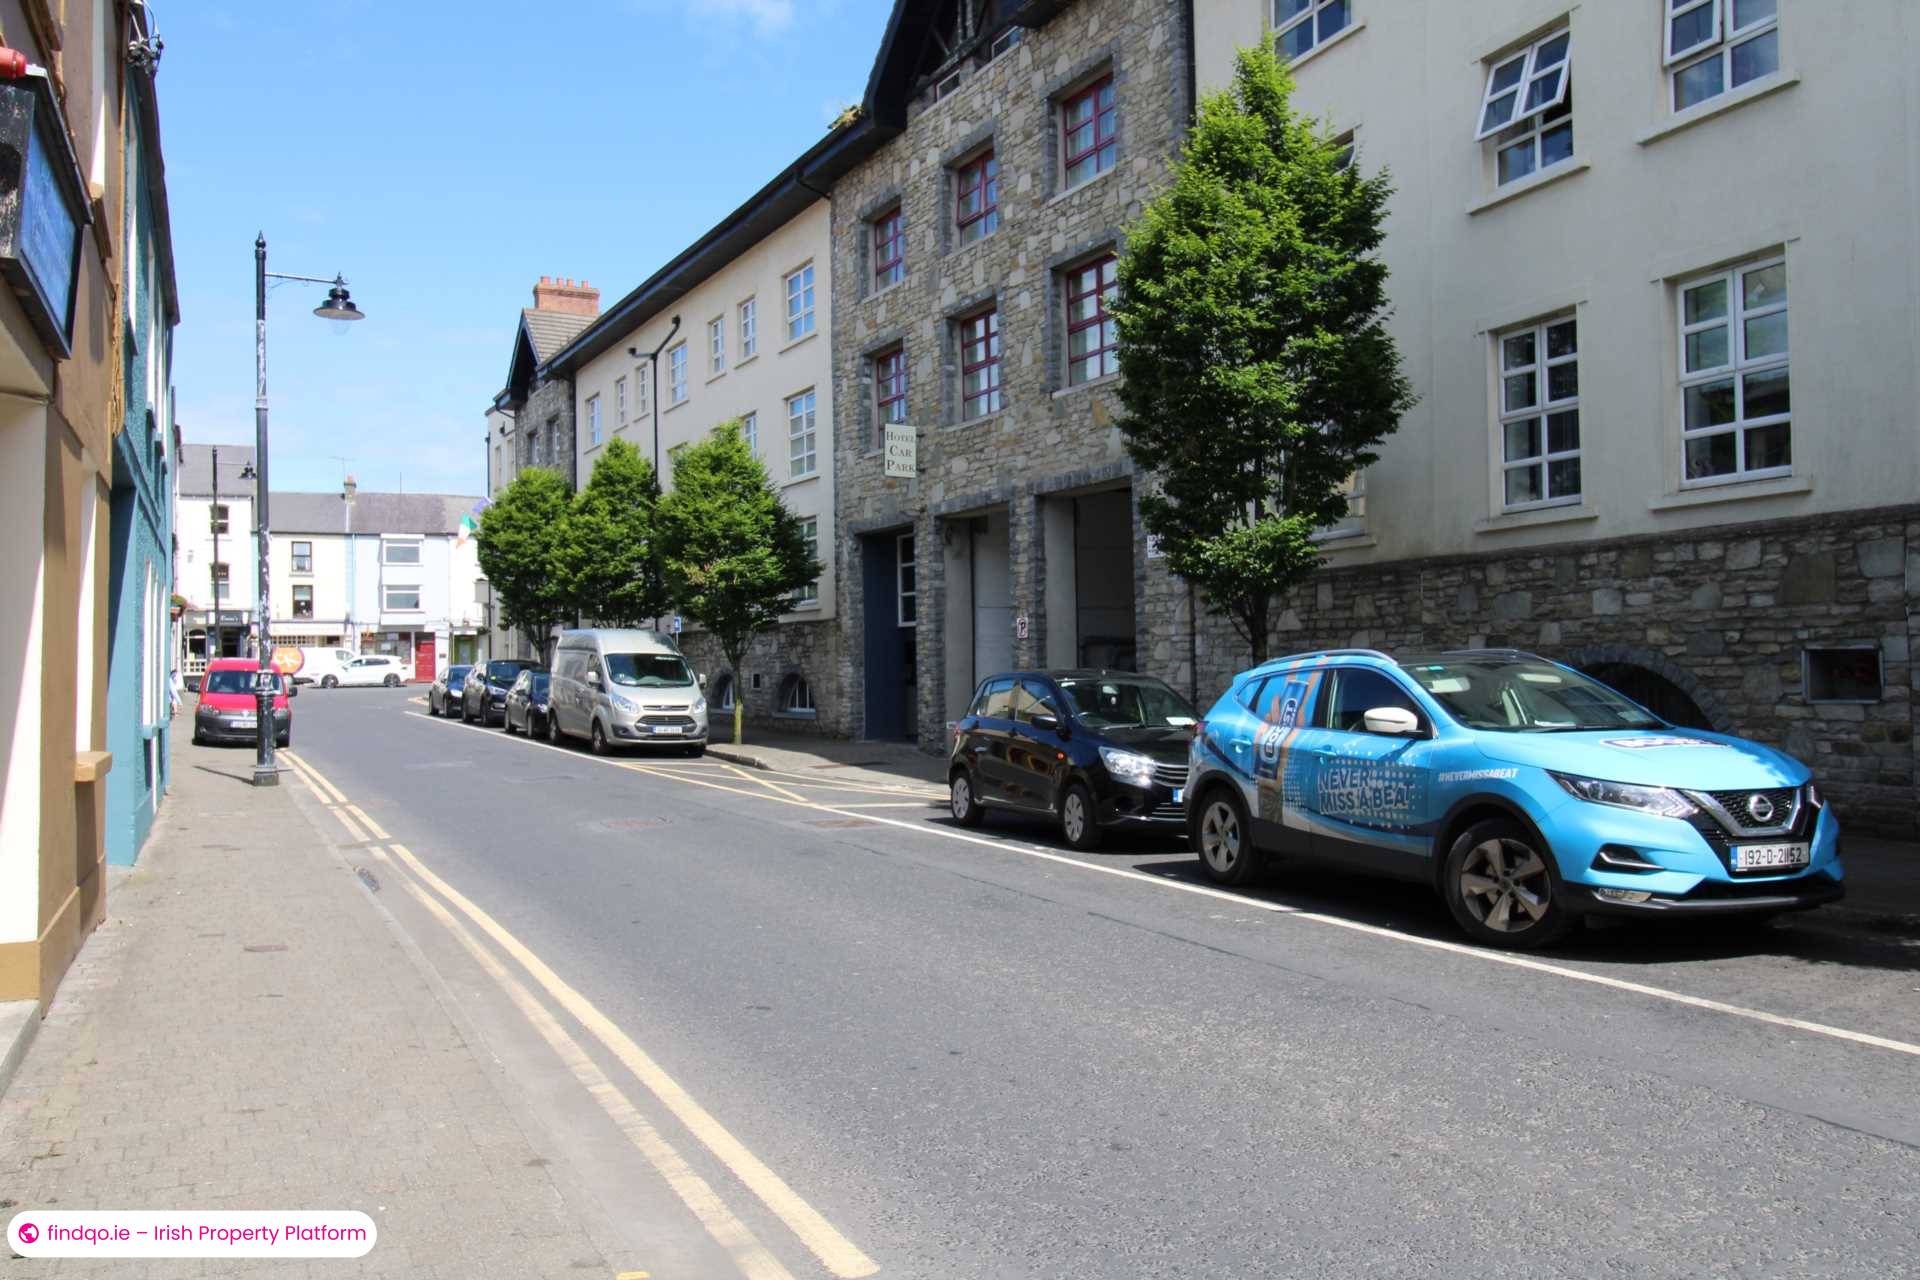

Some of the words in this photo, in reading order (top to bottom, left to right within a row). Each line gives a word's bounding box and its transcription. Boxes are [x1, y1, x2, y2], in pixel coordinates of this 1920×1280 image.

[890, 445, 913, 457] CAR
[887, 460, 916, 472] PARK
[1318, 767, 1370, 792] NEVER
[1320, 789, 1356, 813] MISS
[1359, 785, 1371, 810] A
[1372, 784, 1412, 809] BEAT
